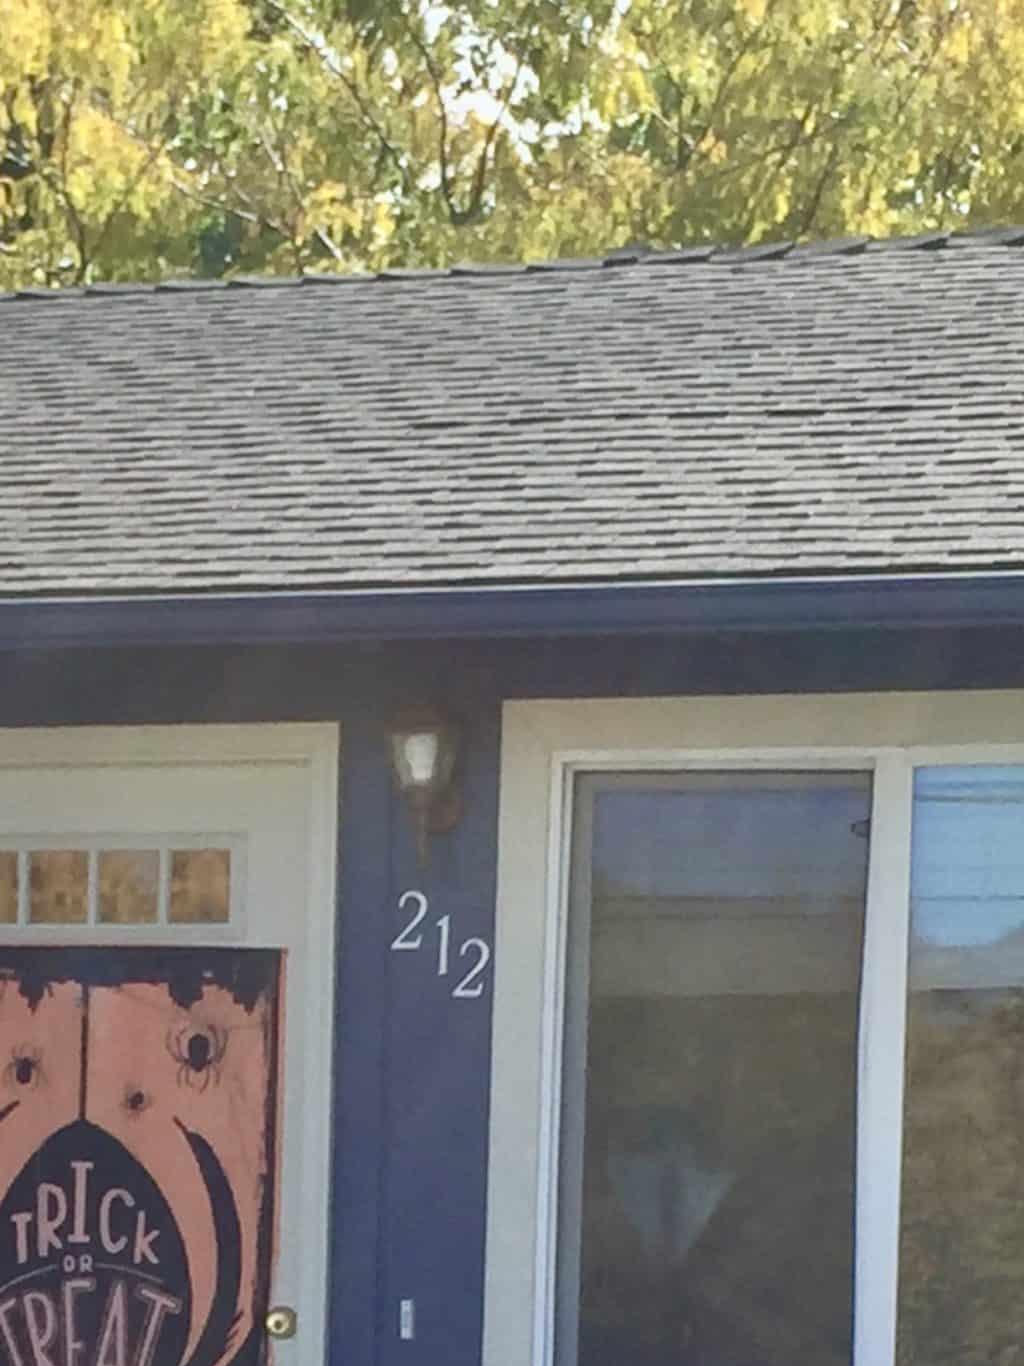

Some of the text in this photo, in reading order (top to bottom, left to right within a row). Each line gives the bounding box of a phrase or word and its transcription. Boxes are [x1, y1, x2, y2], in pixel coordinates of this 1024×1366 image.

[390, 889, 490, 998] 212
[10, 1160, 160, 1264] TRICK
[62, 1254, 93, 1273] OR
